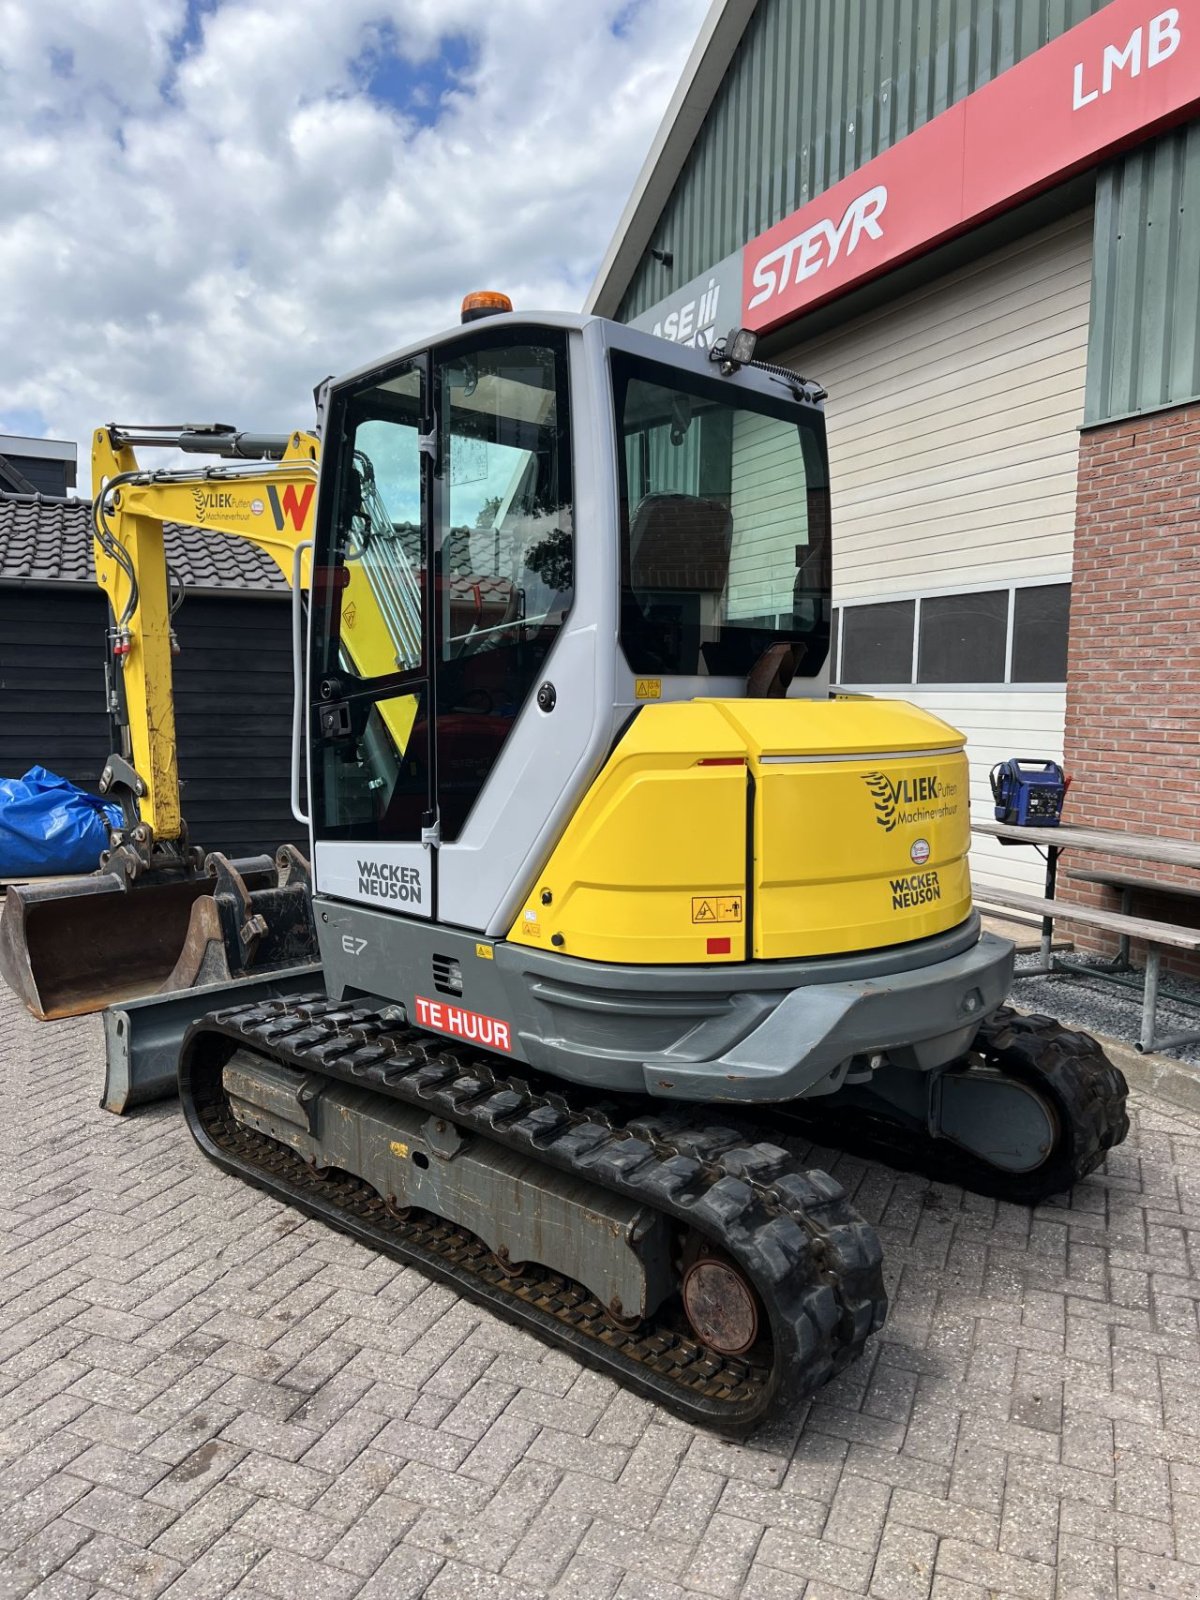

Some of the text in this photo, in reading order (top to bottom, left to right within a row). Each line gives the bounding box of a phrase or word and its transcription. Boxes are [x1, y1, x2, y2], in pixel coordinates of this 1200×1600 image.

[1072, 7, 1182, 112] LMB
[747, 184, 888, 311] STEYR
[651, 300, 696, 342] ASE
[203, 493, 232, 509] VLIEK
[882, 775, 939, 805] VLIEK
[357, 860, 421, 886] WACKER
[889, 871, 939, 894] WACKER
[358, 878, 422, 904] NEUSON
[892, 885, 941, 910] NEUSON
[341, 934, 368, 956] E7
[416, 999, 510, 1049] TE HUUR
